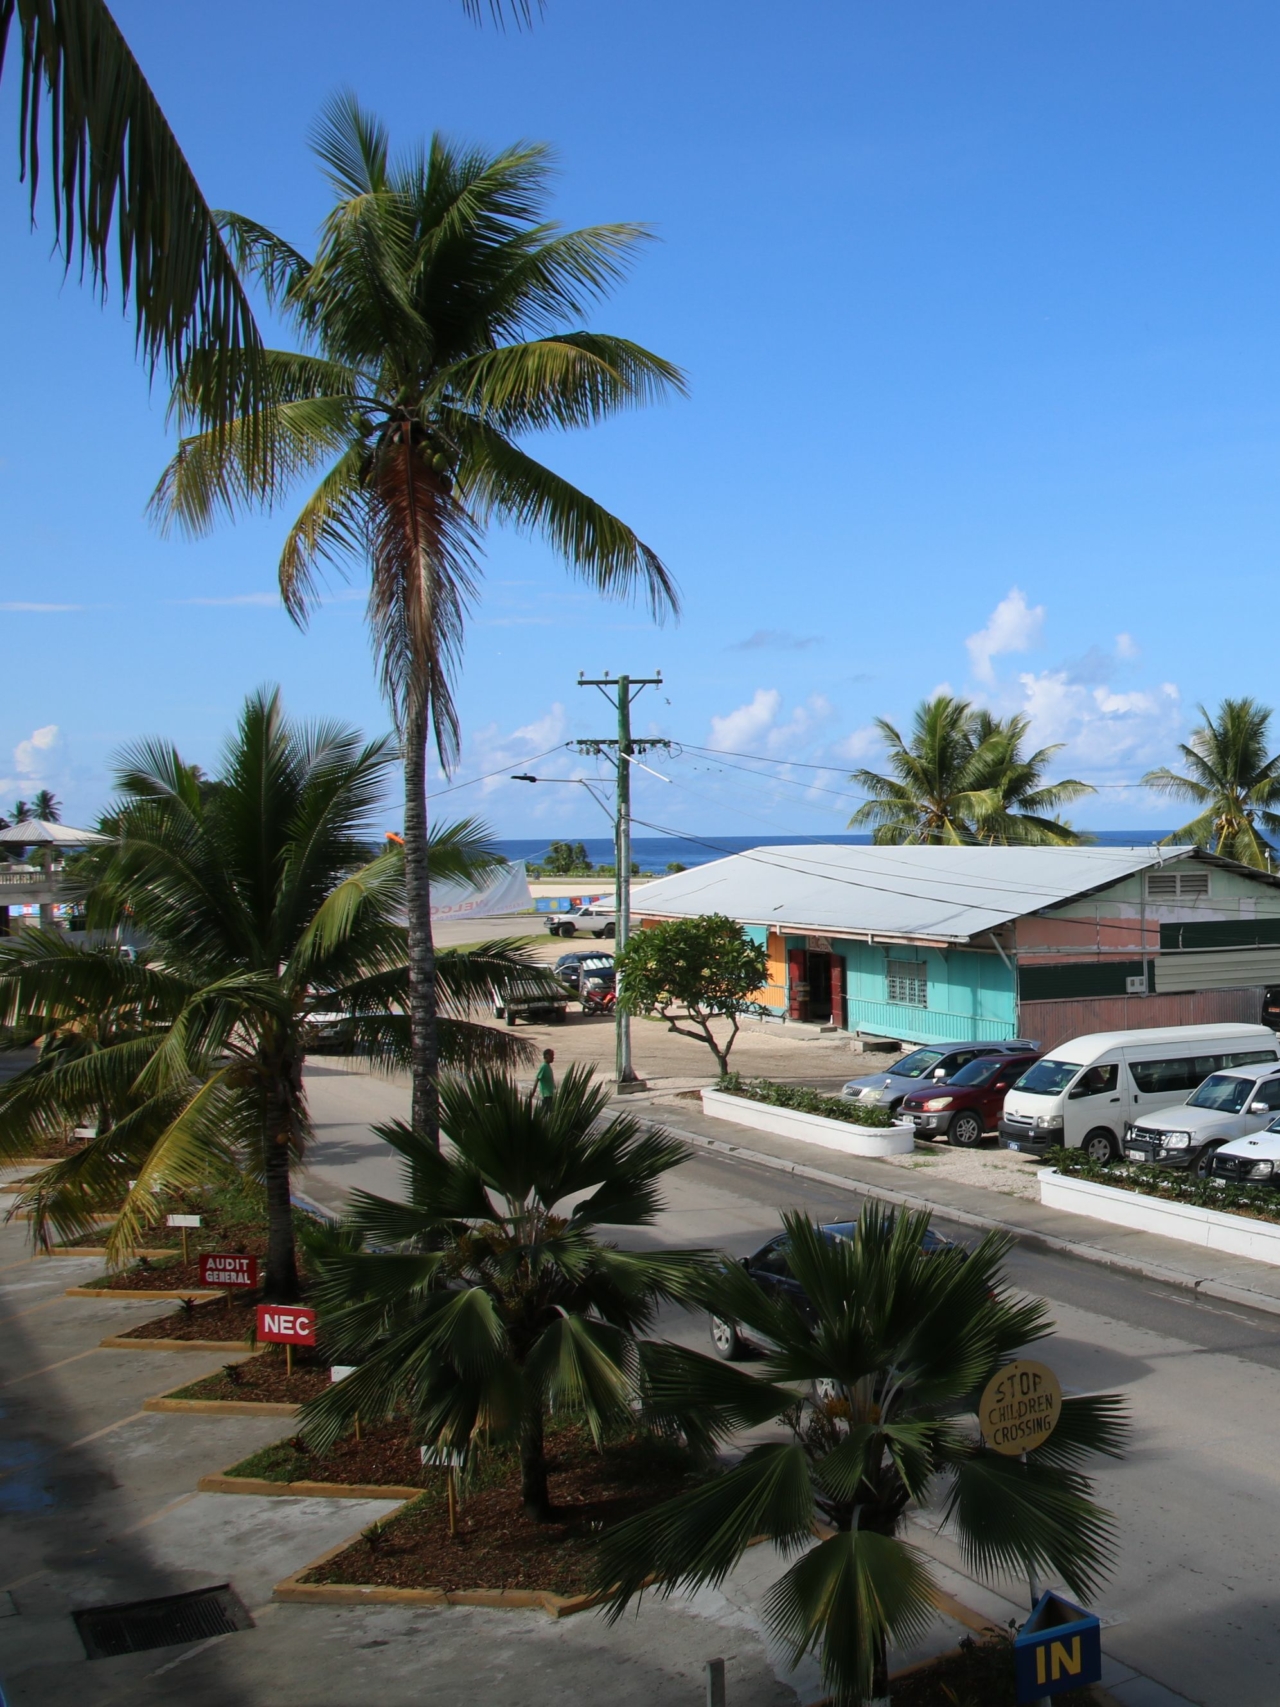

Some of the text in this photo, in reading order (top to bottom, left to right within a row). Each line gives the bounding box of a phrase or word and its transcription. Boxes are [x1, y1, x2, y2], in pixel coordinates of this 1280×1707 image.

[205, 1271, 251, 1284] GENERAL
[206, 1258, 250, 1271] AUDIT
[264, 1314, 310, 1336] NEC
[995, 1371, 1042, 1404] STOP
[988, 1393, 1053, 1425] CHILDREN
[993, 1414, 1052, 1445] CROSSING
[1036, 1635, 1081, 1685] IN
